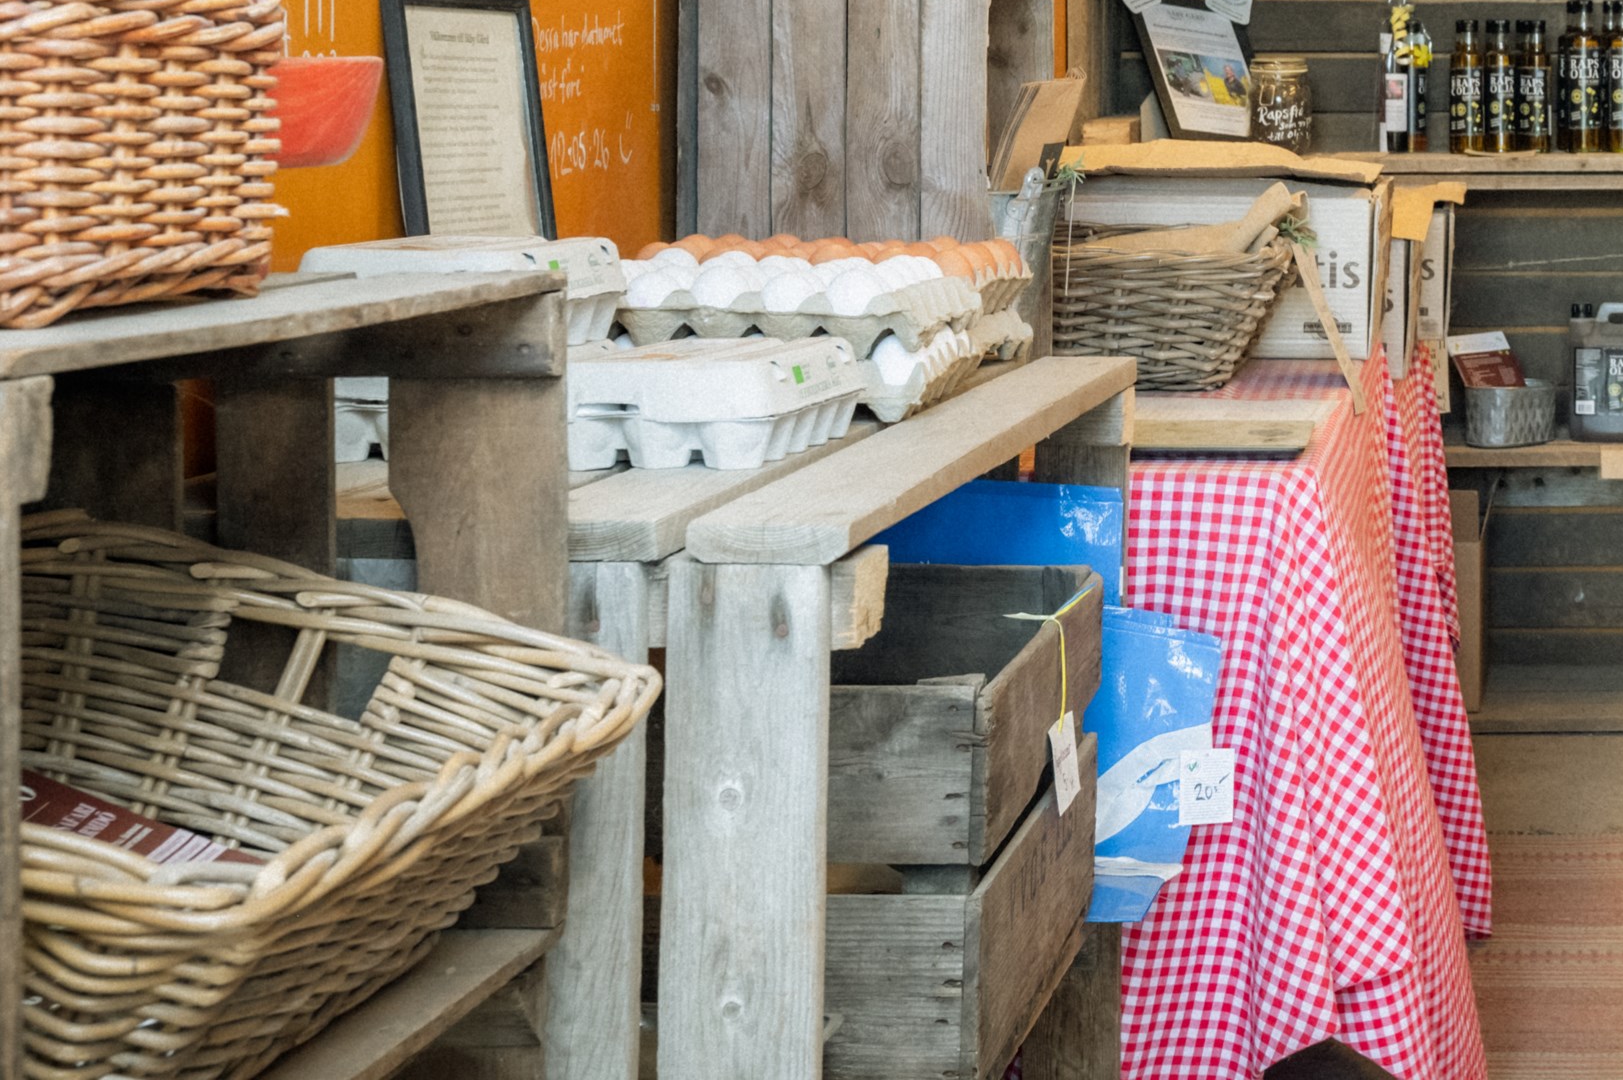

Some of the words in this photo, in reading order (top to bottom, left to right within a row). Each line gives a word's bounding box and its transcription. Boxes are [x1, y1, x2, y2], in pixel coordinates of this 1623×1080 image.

[532, 16, 560, 53] Dessa
[561, 14, 580, 49] har
[1570, 58, 1600, 70] RAPS
[1570, 70, 1600, 80] OLJA
[540, 63, 558, 102] äst
